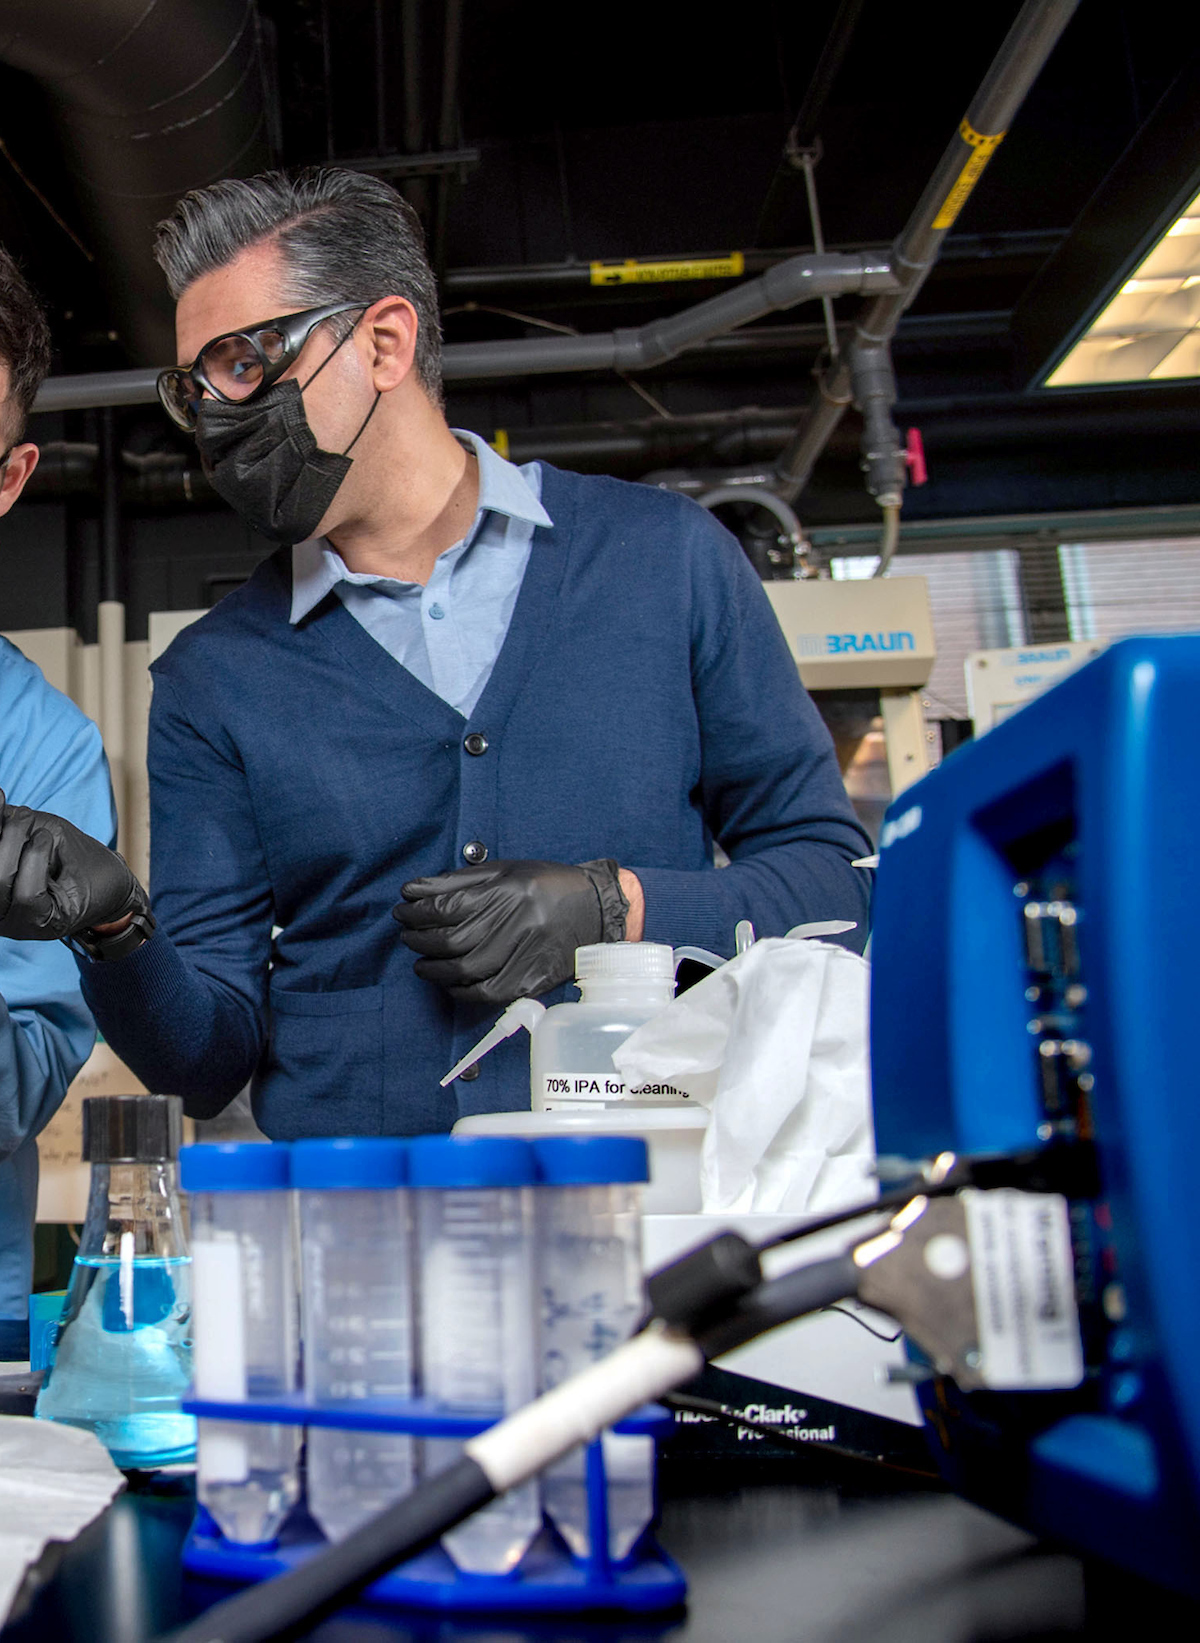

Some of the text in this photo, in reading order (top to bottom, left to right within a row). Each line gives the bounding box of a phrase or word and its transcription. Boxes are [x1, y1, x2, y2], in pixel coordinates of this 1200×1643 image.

[546, 1079, 690, 1098] 70% IPA for ceanig
